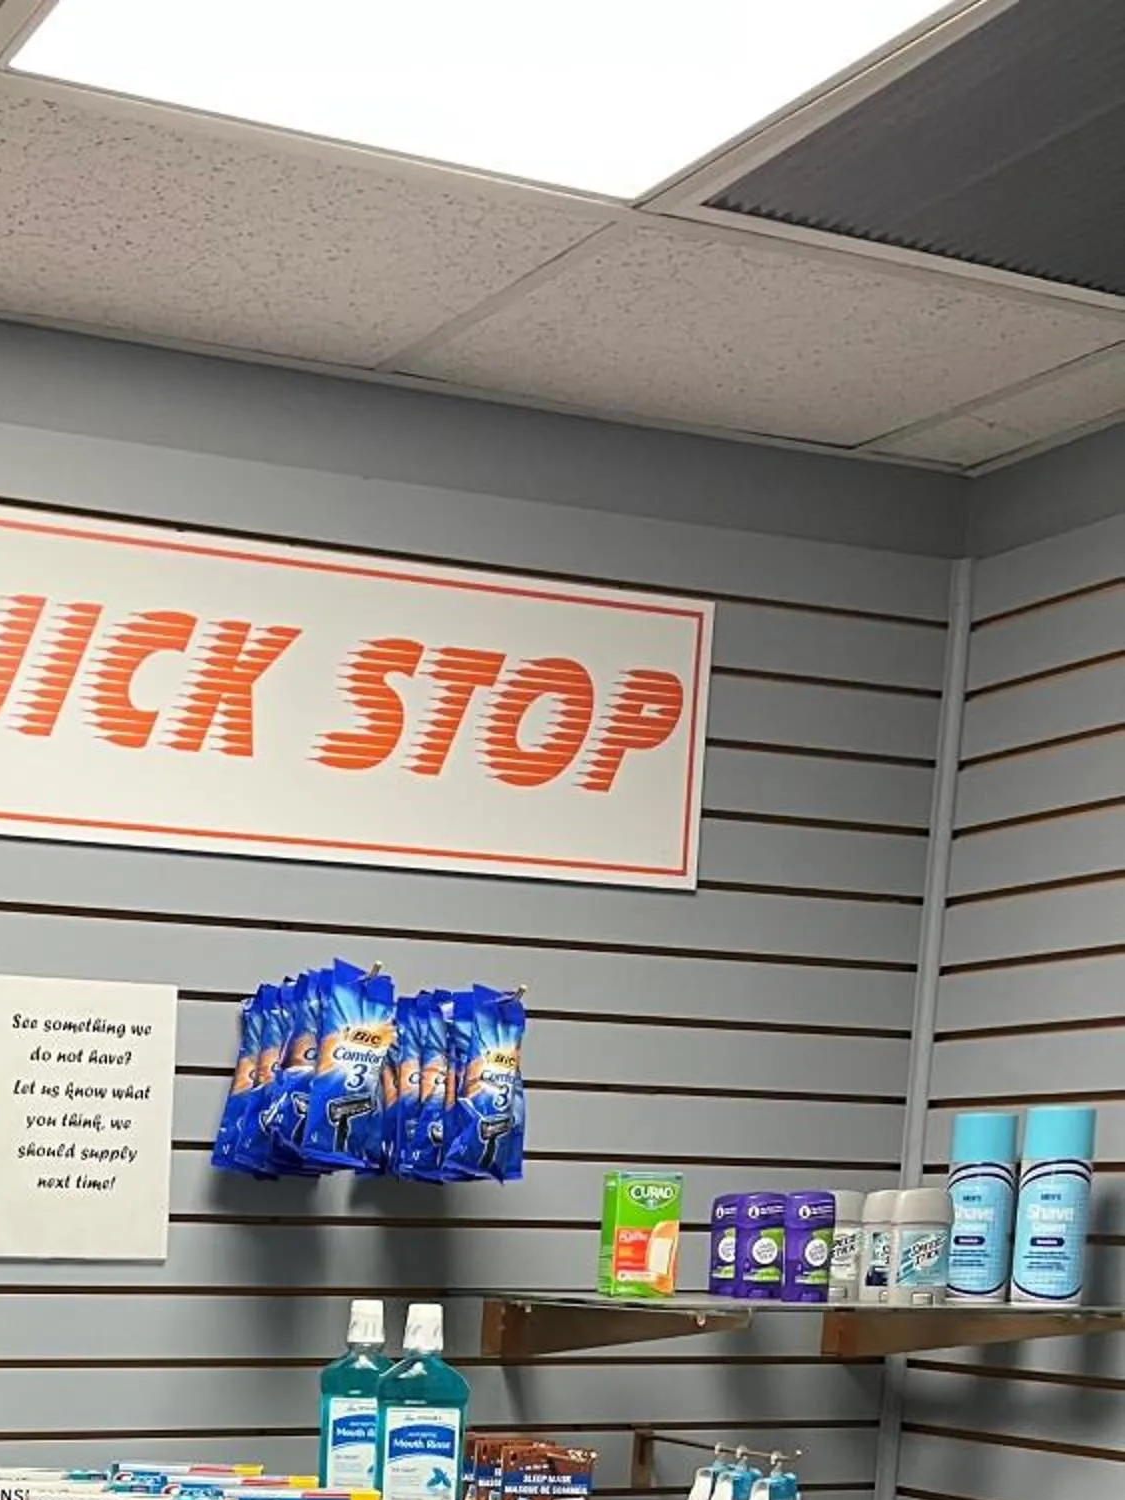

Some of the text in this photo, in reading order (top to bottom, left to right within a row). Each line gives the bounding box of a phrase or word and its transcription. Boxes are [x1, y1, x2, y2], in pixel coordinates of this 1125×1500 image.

[305, 637, 684, 793] STOP
[12, 1013, 152, 1039] See something we
[30, 1045, 132, 1065] do not have?
[346, 1064, 369, 1089] 3
[13, 1079, 151, 1101] Let us know what
[494, 1084, 510, 1108] 3
[26, 1115, 57, 1129] you
[110, 1118, 132, 1130] we
[17, 1142, 138, 1163] should supply
[37, 1174, 116, 1191] next time!
[630, 1185, 674, 1199] CURAD
[393, 1438, 452, 1450] Mouth Rinse
